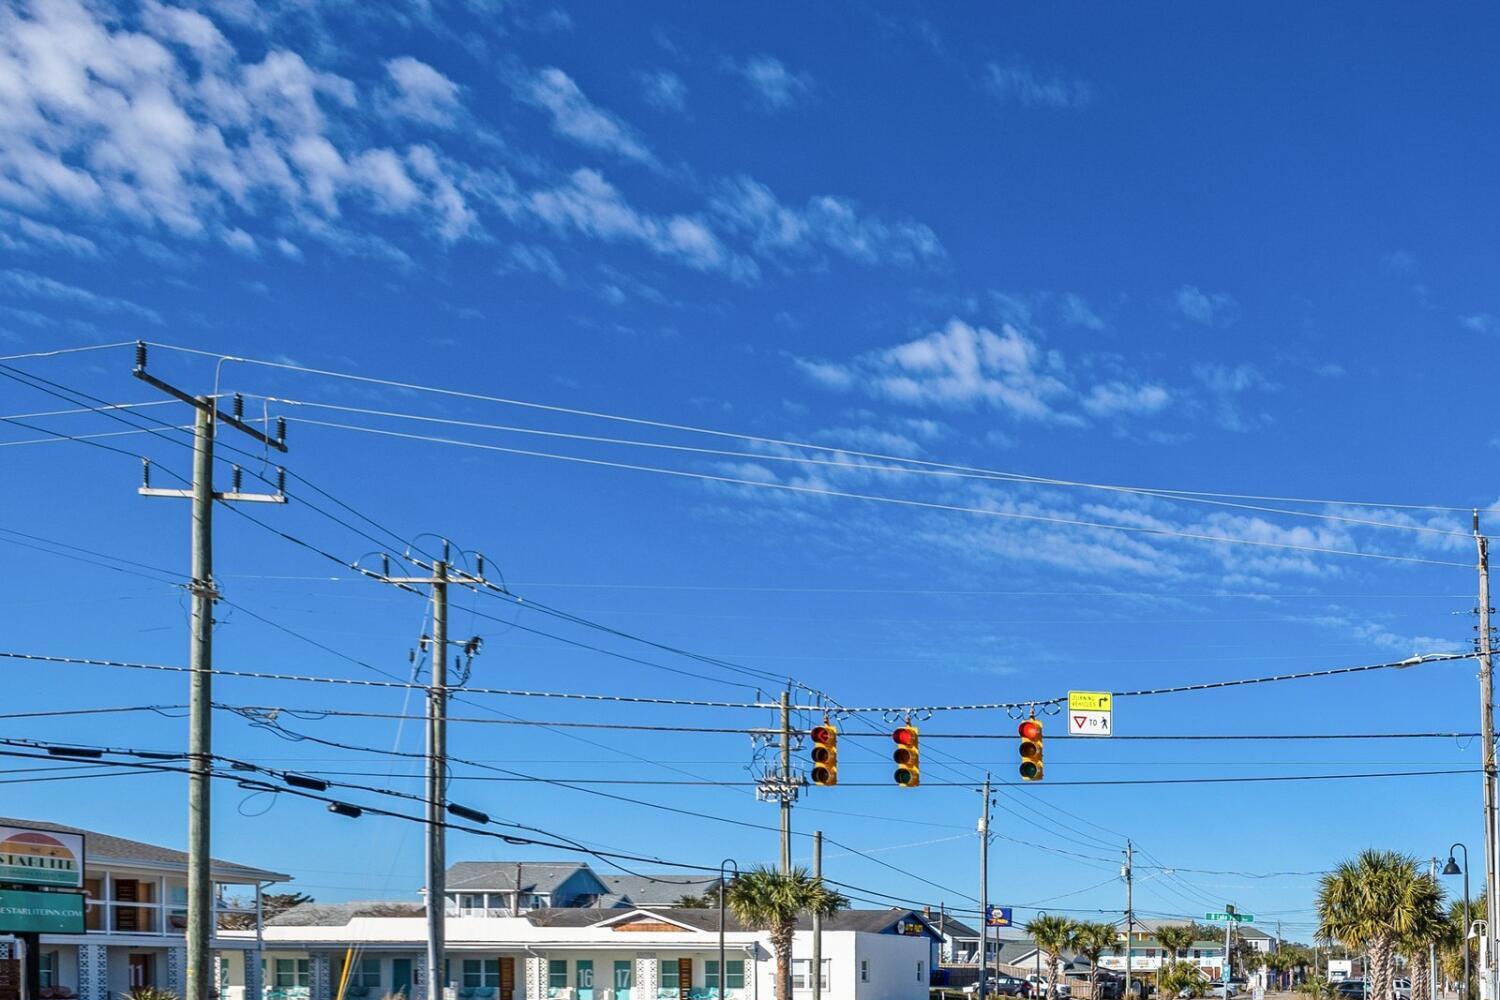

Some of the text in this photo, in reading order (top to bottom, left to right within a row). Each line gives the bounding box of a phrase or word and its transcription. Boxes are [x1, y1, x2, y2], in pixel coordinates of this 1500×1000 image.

[1089, 719, 1098, 727] TO
[129, 963, 144, 987] 11
[578, 968, 593, 988] 16
[615, 968, 631, 988] 17
